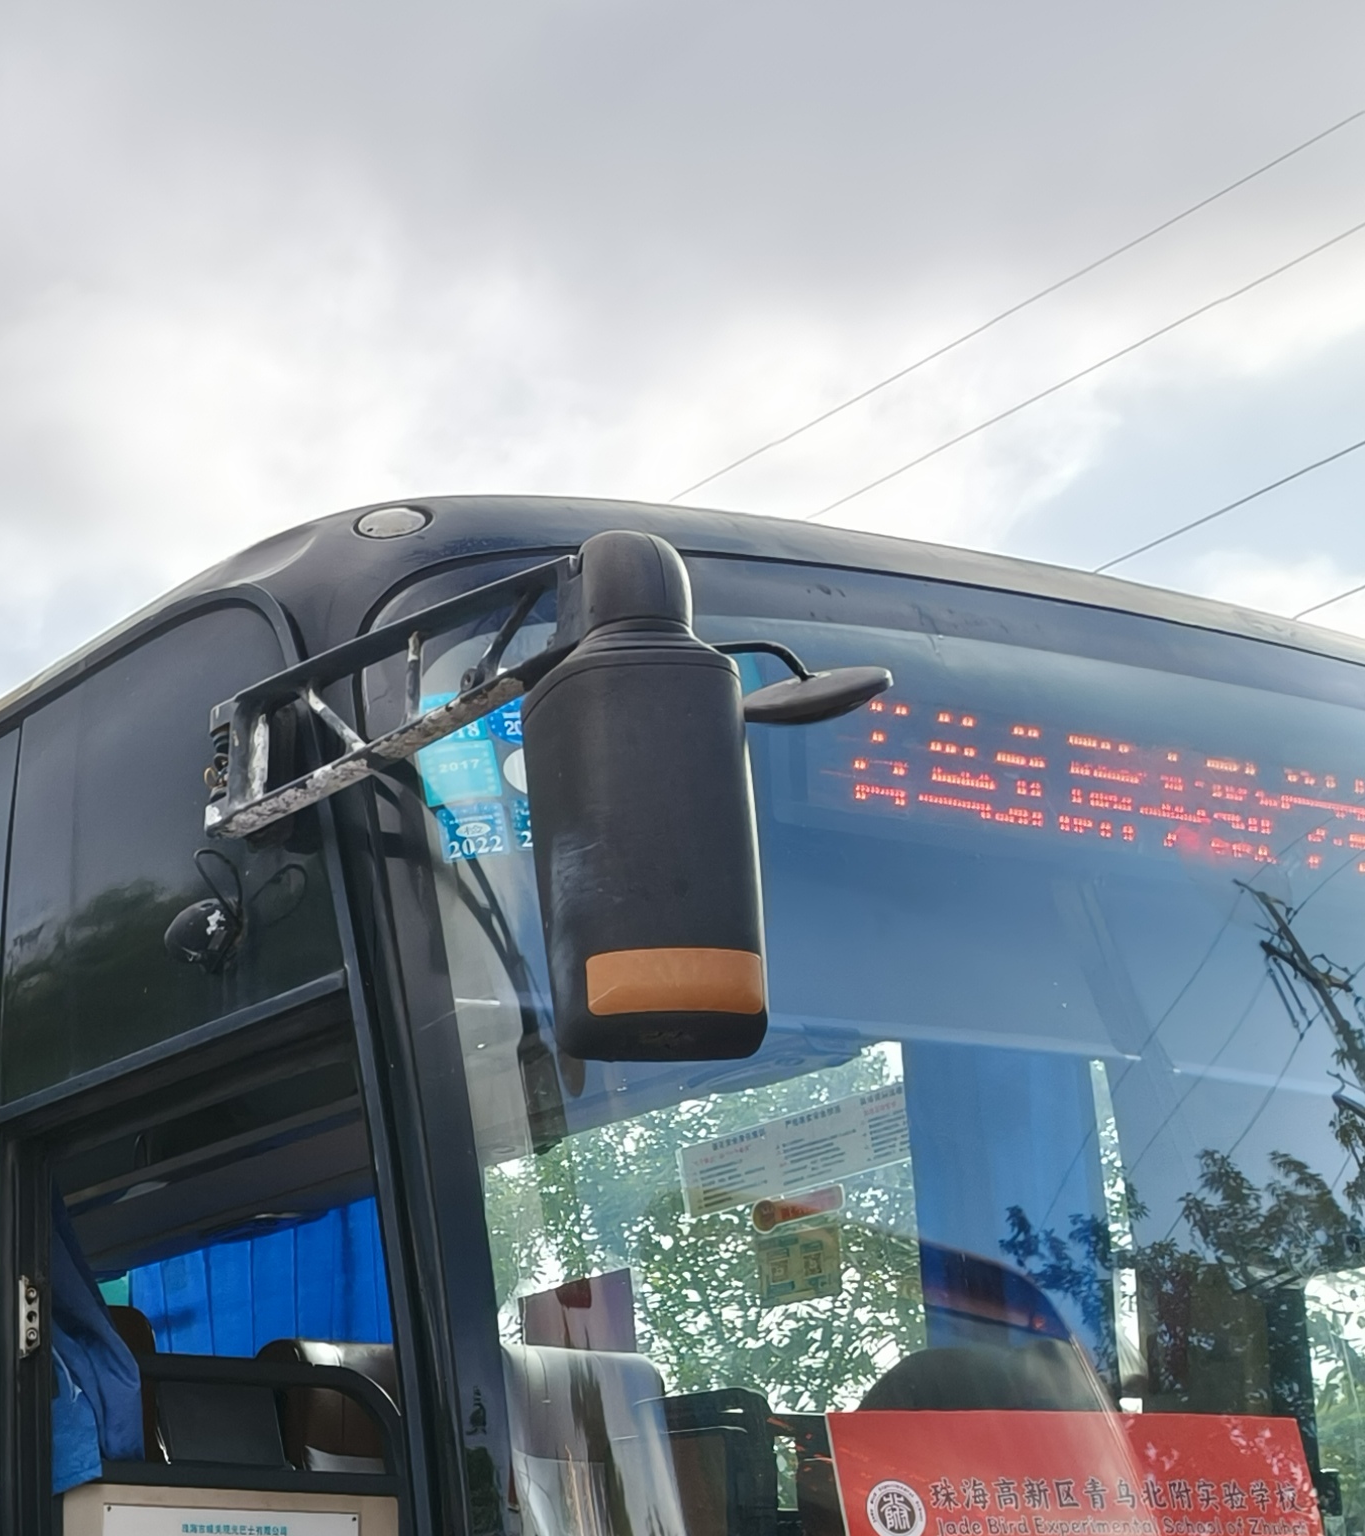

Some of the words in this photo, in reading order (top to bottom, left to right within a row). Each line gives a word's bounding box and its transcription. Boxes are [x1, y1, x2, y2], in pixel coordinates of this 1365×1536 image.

[438, 758, 481, 774] 2017
[448, 835, 504, 859] 2022
[987, 1516, 1031, 1536] Bird
[1162, 1517, 1222, 1536] School
[1226, 1518, 1244, 1535] of
